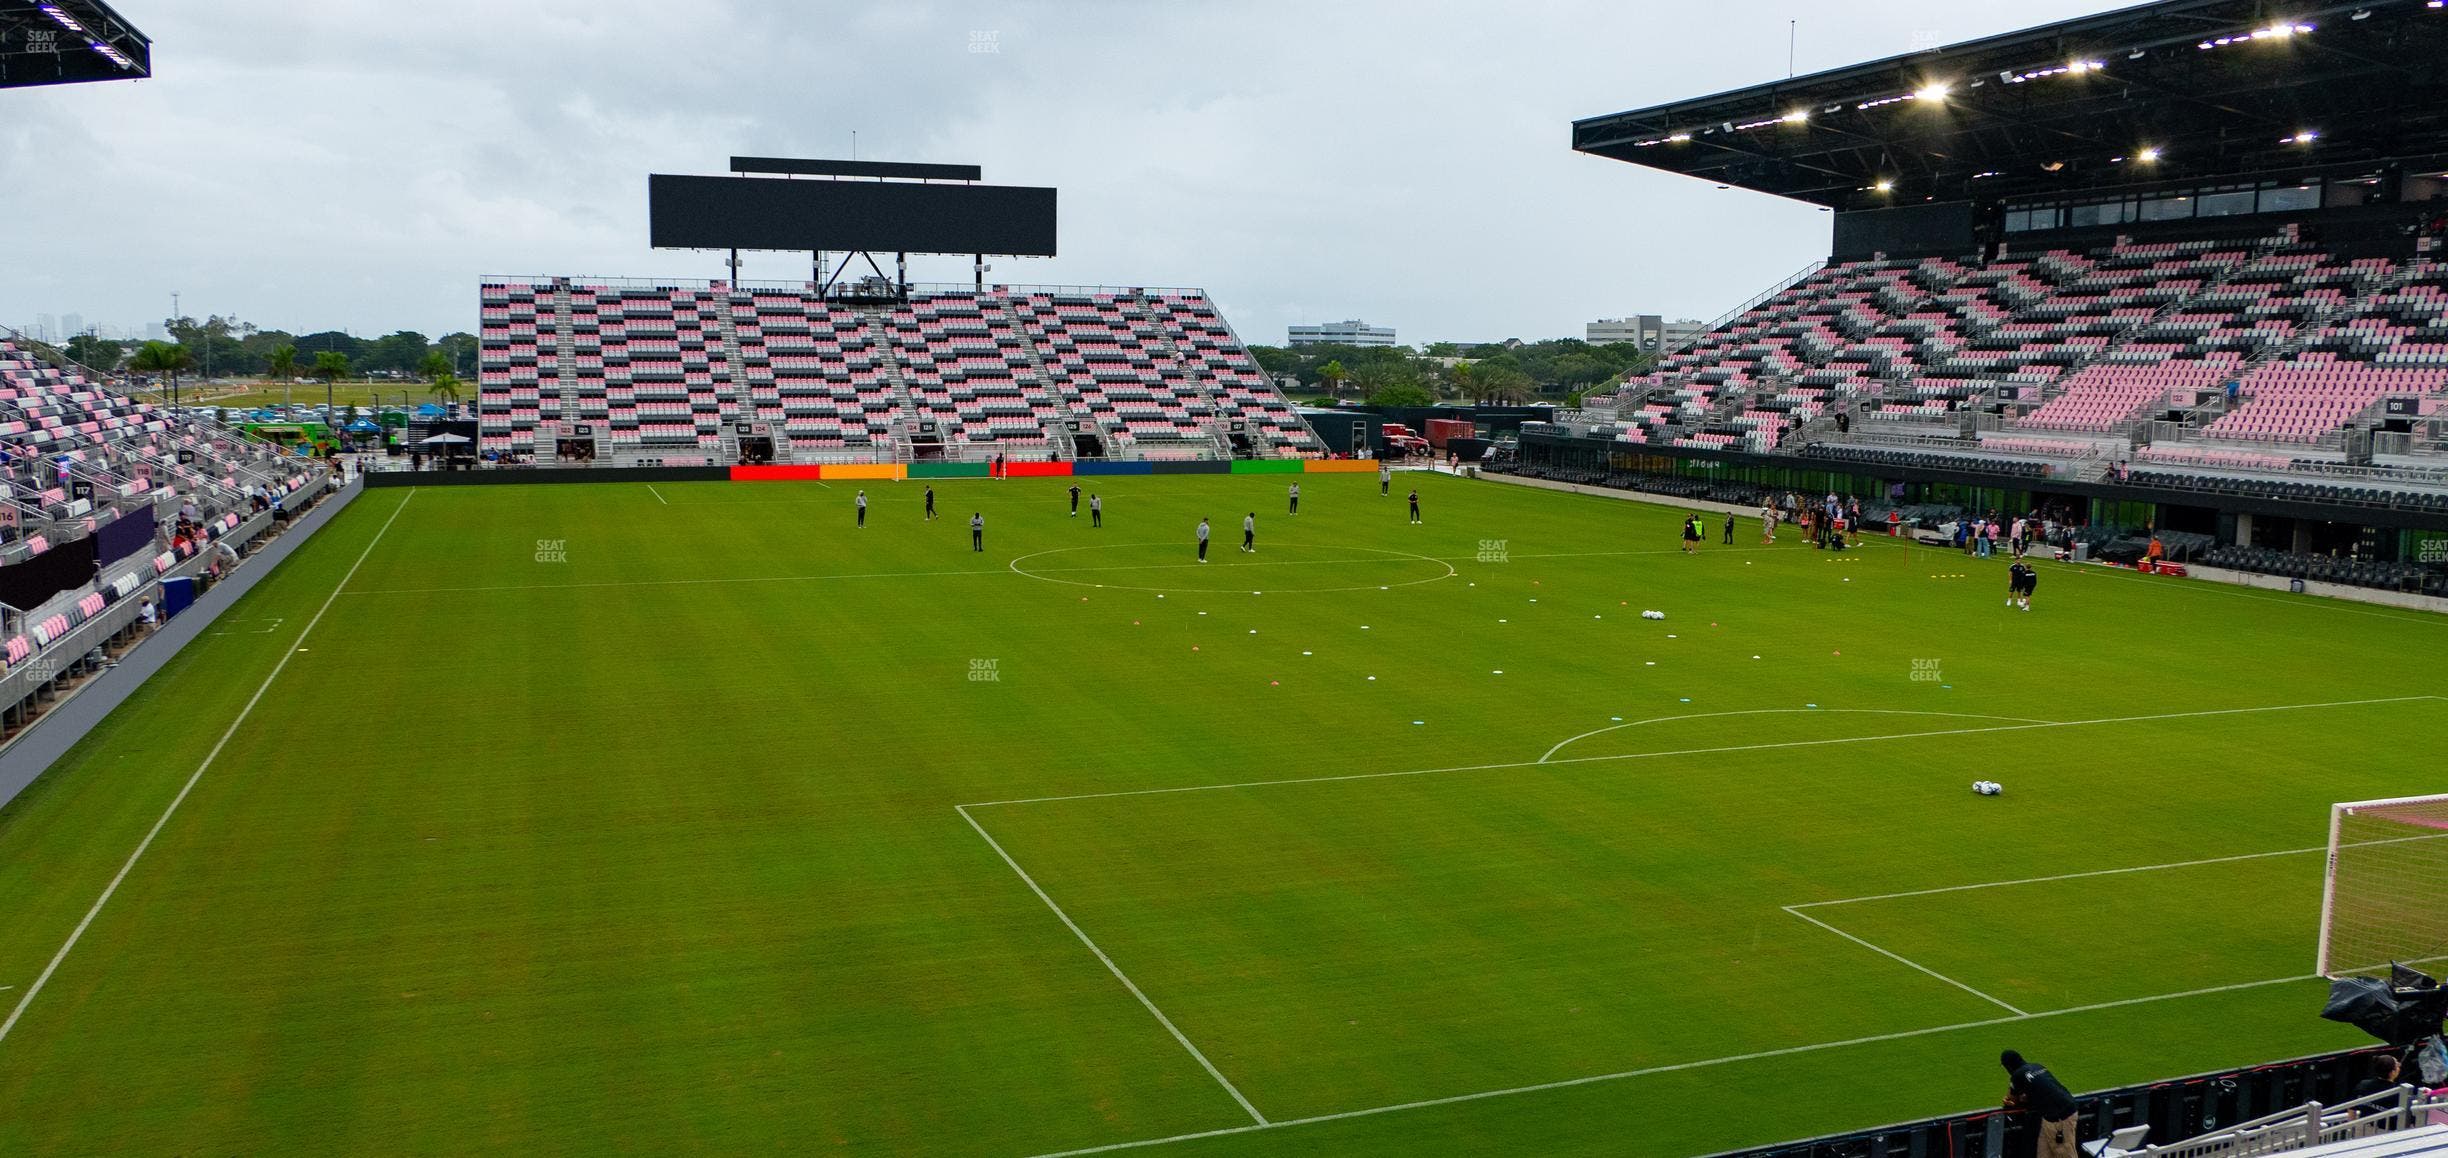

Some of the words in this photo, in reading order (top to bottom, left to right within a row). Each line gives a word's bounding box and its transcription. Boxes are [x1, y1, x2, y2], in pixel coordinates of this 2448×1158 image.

[2390, 402, 2403, 411] 101
[136, 468, 150, 476] 118
[75, 486, 91, 495] 117
